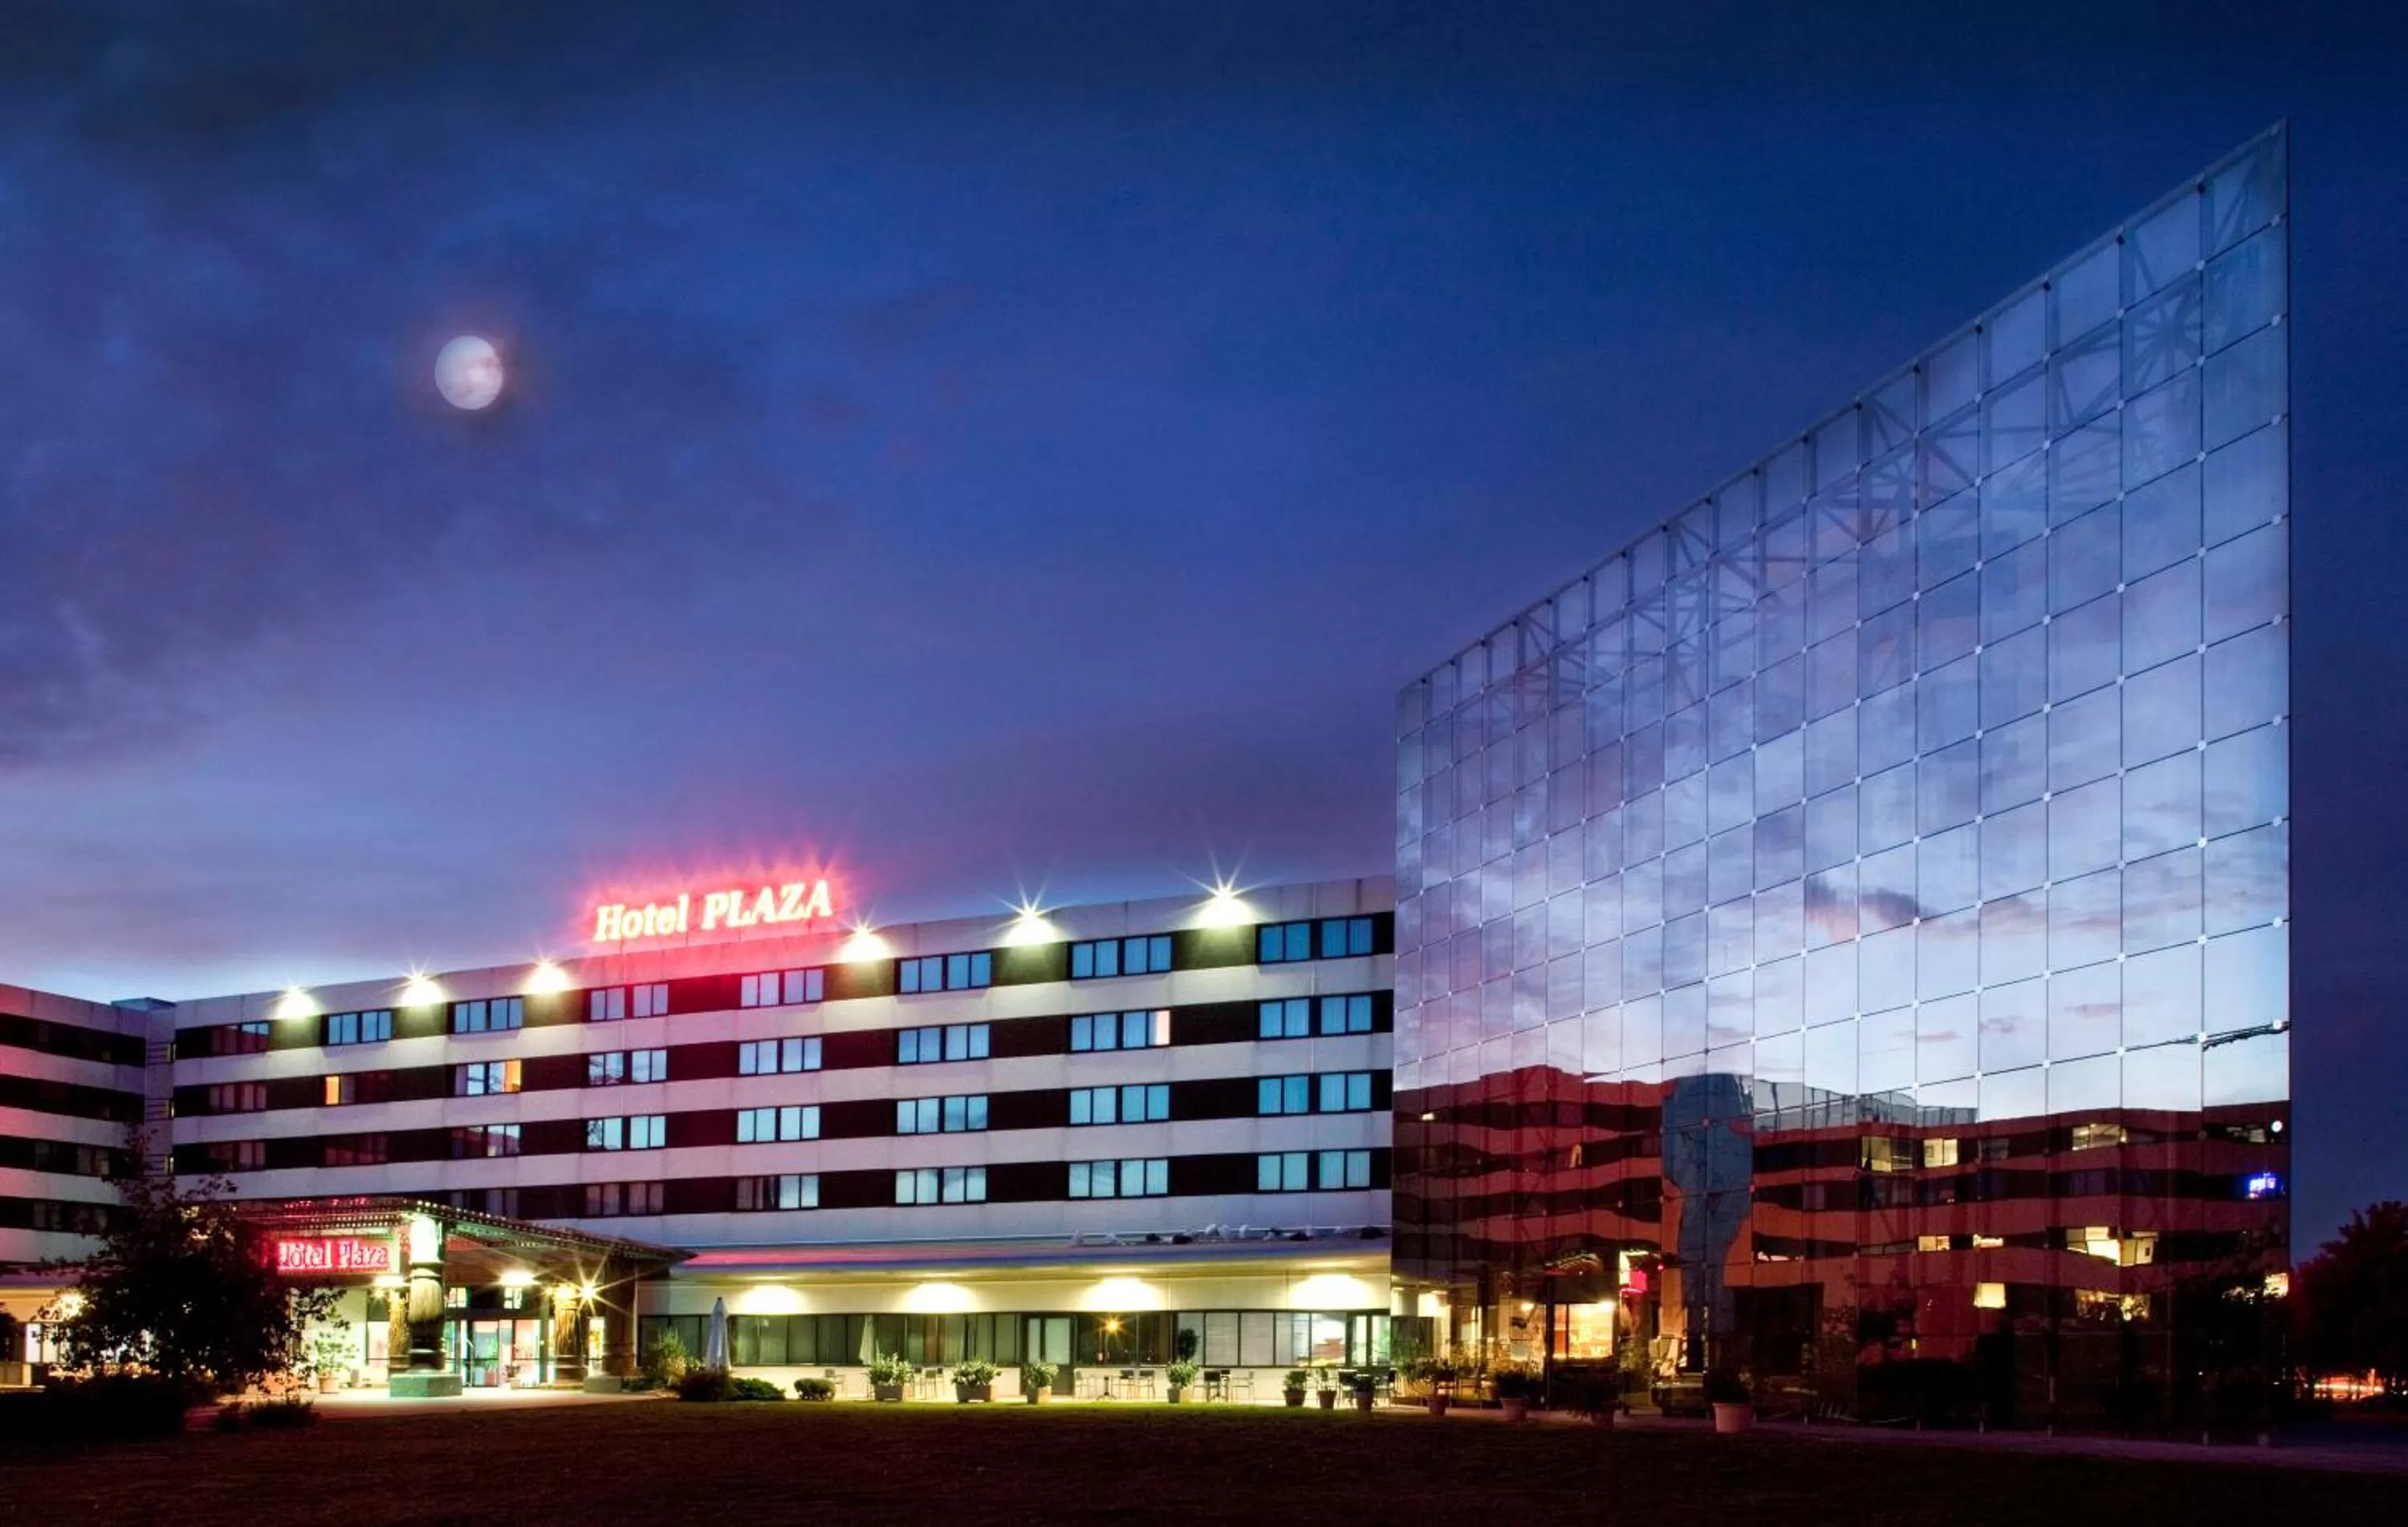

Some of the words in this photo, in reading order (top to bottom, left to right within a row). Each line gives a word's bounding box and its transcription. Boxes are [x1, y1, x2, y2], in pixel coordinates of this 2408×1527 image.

[593, 894, 689, 942] Hotel
[701, 880, 832, 930] PLAZA
[338, 1239, 389, 1268] Plaza
